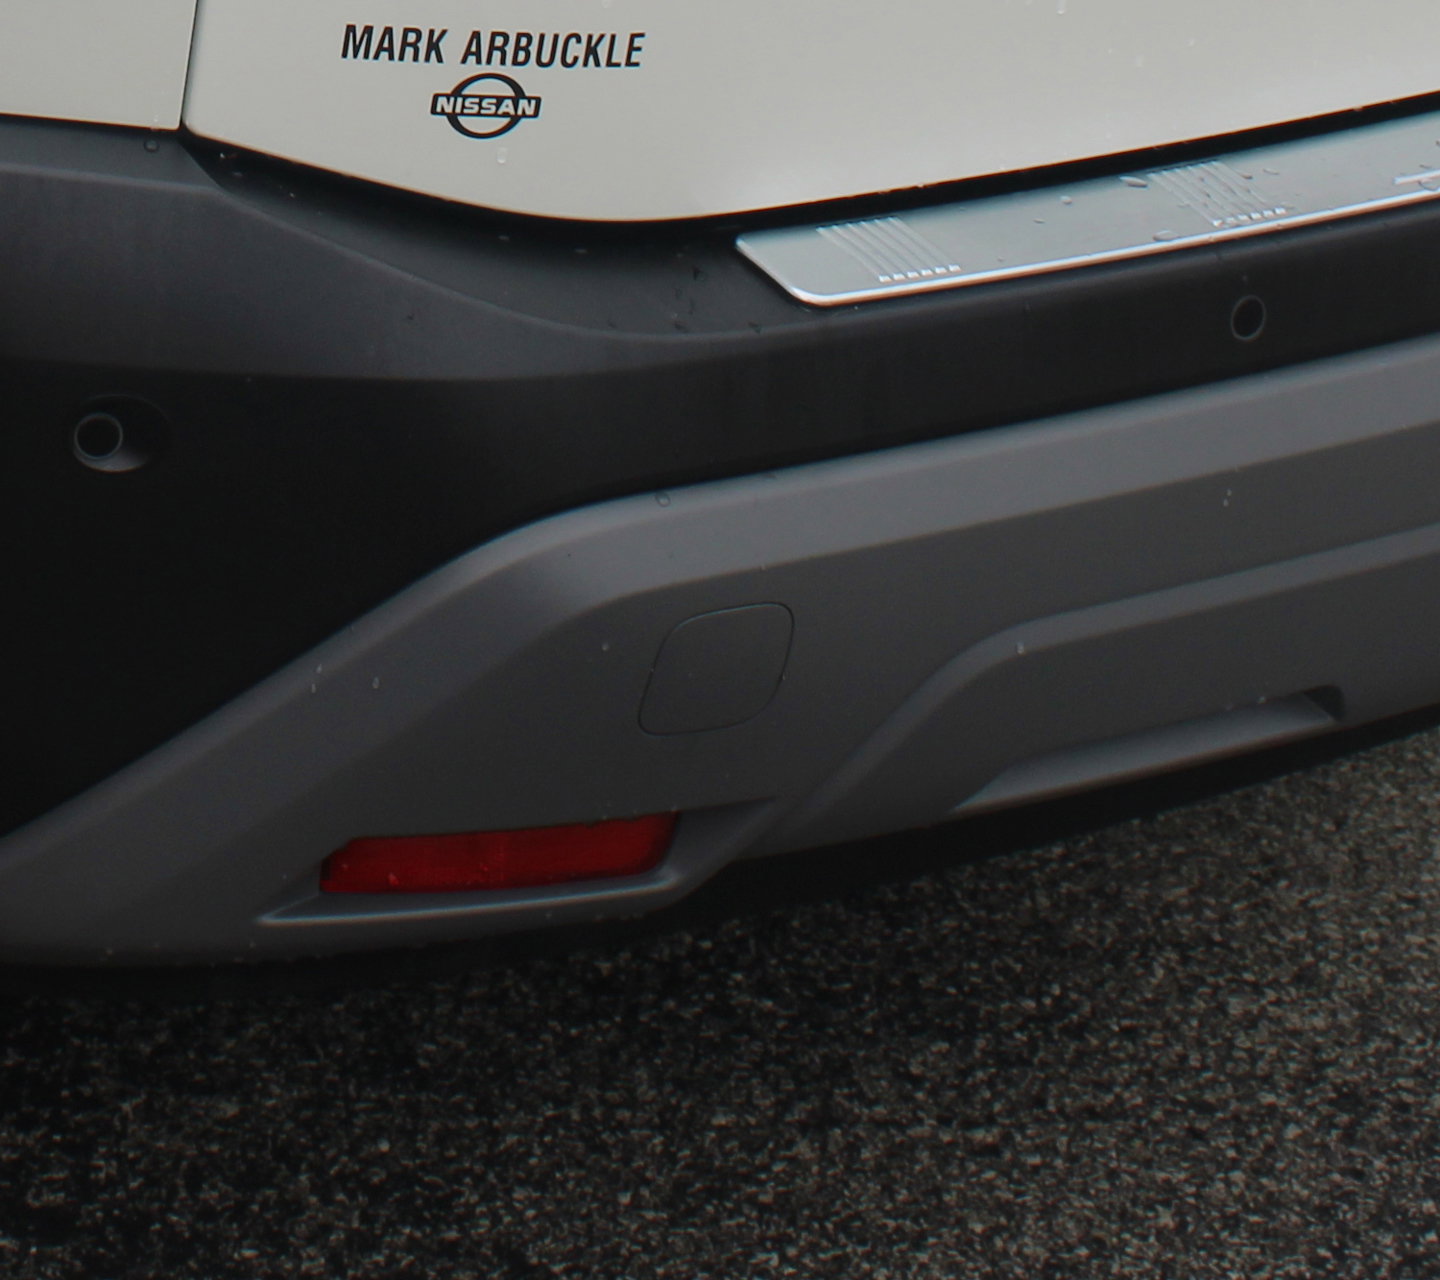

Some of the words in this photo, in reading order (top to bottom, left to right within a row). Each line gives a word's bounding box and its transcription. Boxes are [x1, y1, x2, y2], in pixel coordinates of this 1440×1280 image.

[340, 23, 449, 65] MARK
[460, 29, 647, 69] ARBUCKLE
[435, 95, 538, 117] NISSAN
